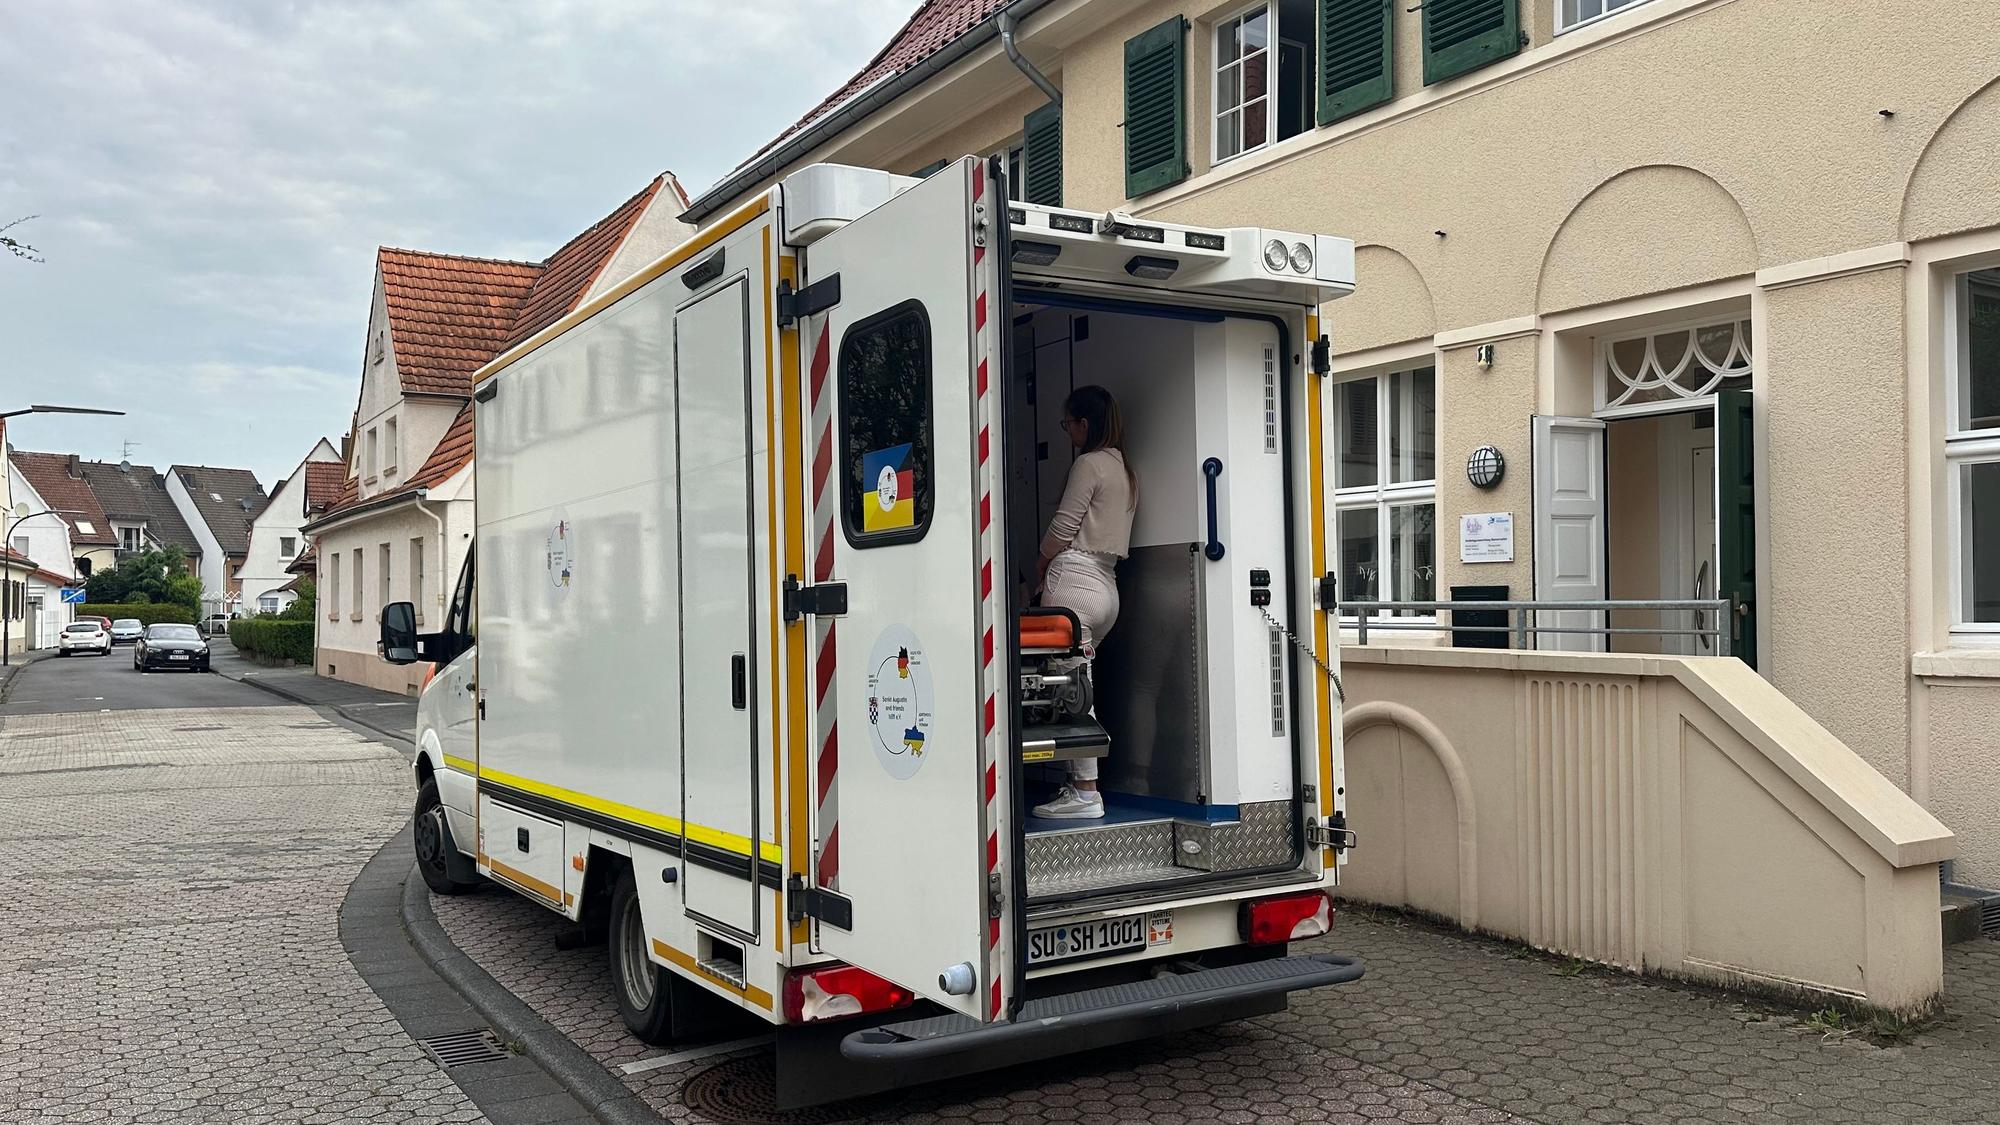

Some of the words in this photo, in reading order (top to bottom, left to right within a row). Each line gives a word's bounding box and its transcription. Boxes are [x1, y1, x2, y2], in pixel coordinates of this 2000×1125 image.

[1030, 931, 1055, 959] SU
[1070, 925, 1094, 952] SH
[1099, 918, 1143, 948] 1001
